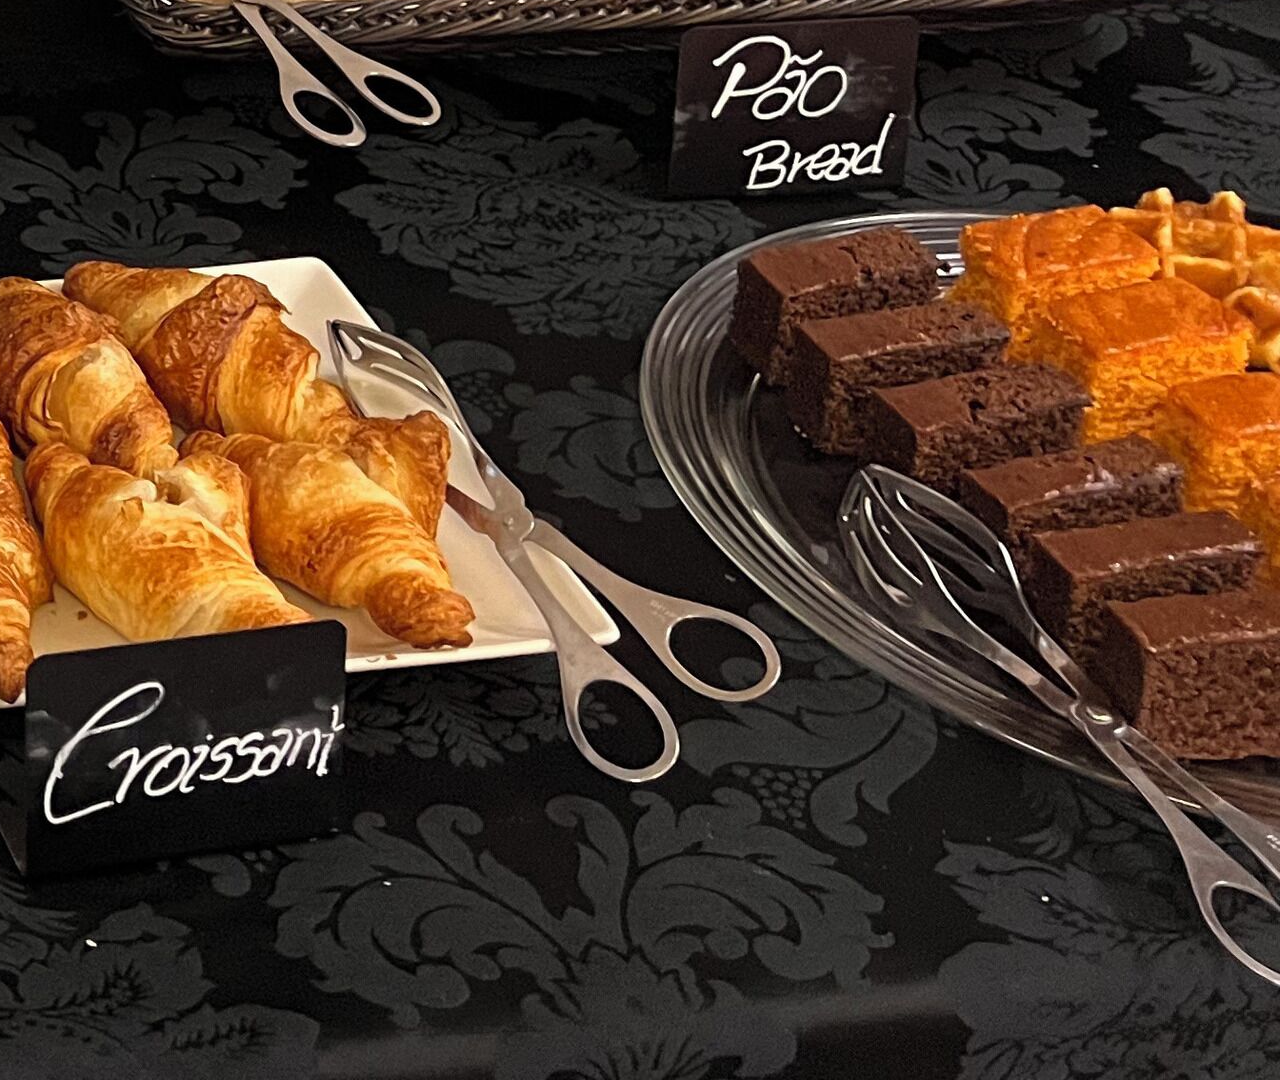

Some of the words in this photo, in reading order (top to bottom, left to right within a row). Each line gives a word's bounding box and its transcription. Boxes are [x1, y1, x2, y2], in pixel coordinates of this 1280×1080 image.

[711, 35, 848, 120] Pão
[743, 112, 895, 190] Bread
[44, 681, 344, 824] Croissant
